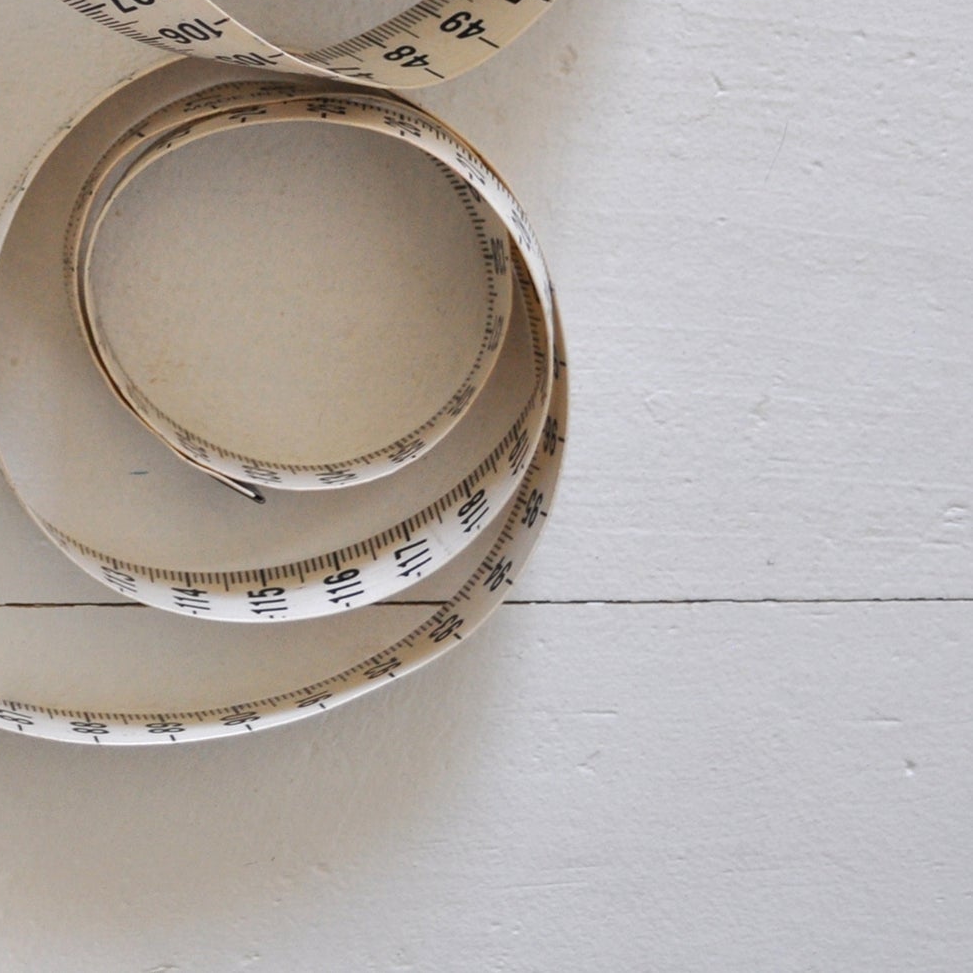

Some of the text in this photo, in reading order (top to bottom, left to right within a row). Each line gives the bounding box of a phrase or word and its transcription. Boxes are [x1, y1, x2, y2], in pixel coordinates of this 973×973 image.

[158, 18, 223, 44] 106
[440, 11, 485, 40] 49
[383, 45, 430, 69] 48
[457, 489, 489, 533] 118
[521, 489, 543, 528] 95
[394, 539, 432, 577] 117
[324, 568, 364, 603] 116
[483, 556, 512, 591] 94
[171, 587, 211, 610] 114
[247, 587, 288, 614] 115
[429, 614, 464, 643] 93
[68, 721, 109, 735] 88
[220, 711, 260, 727] 90
